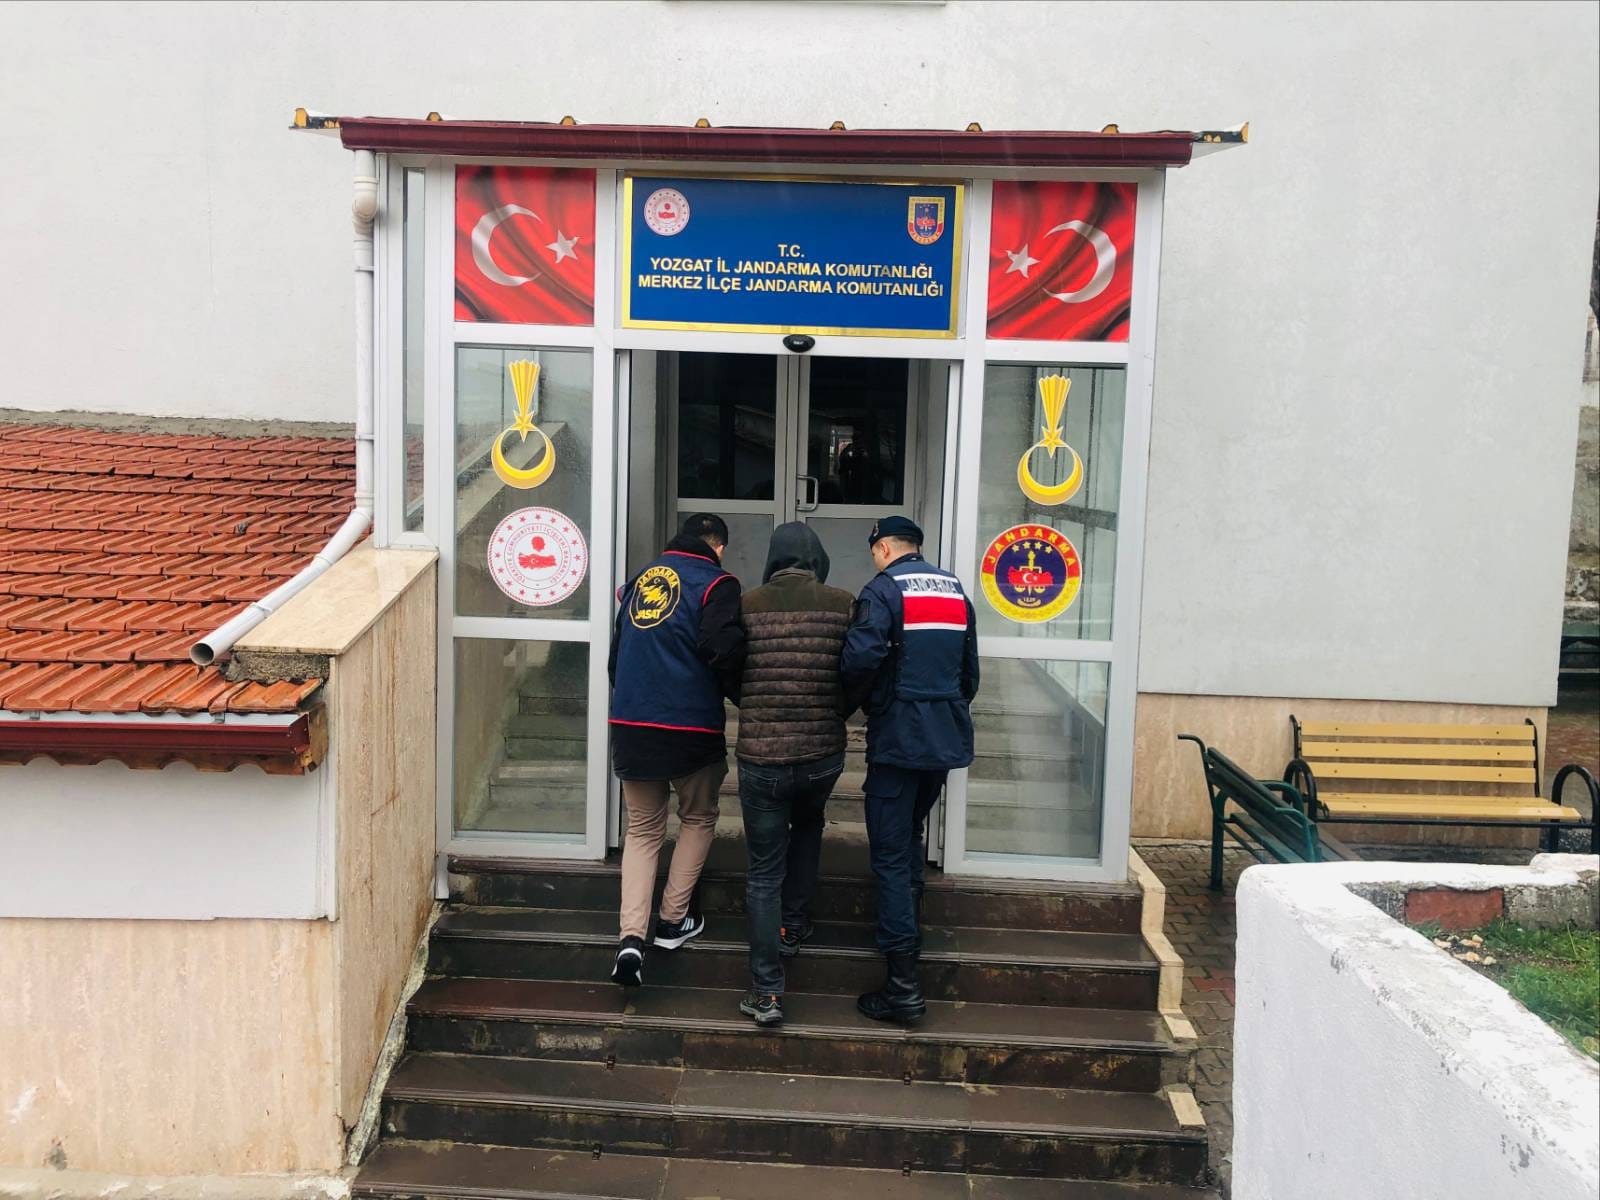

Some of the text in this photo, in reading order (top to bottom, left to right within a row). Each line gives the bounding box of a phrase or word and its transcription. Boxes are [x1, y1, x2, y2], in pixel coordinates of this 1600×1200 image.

[778, 243, 805, 258] T.C.
[650, 256, 933, 279] YOZGAT İL JANDARMA KOMUTANLIĞI
[638, 274, 944, 297] MERKEZ İLÇE JANDARMA KOMUTANLIĞI
[986, 527, 1076, 567] JANDARMA
[905, 577, 958, 594] JANDARMA
[635, 609, 661, 620] JASAT
